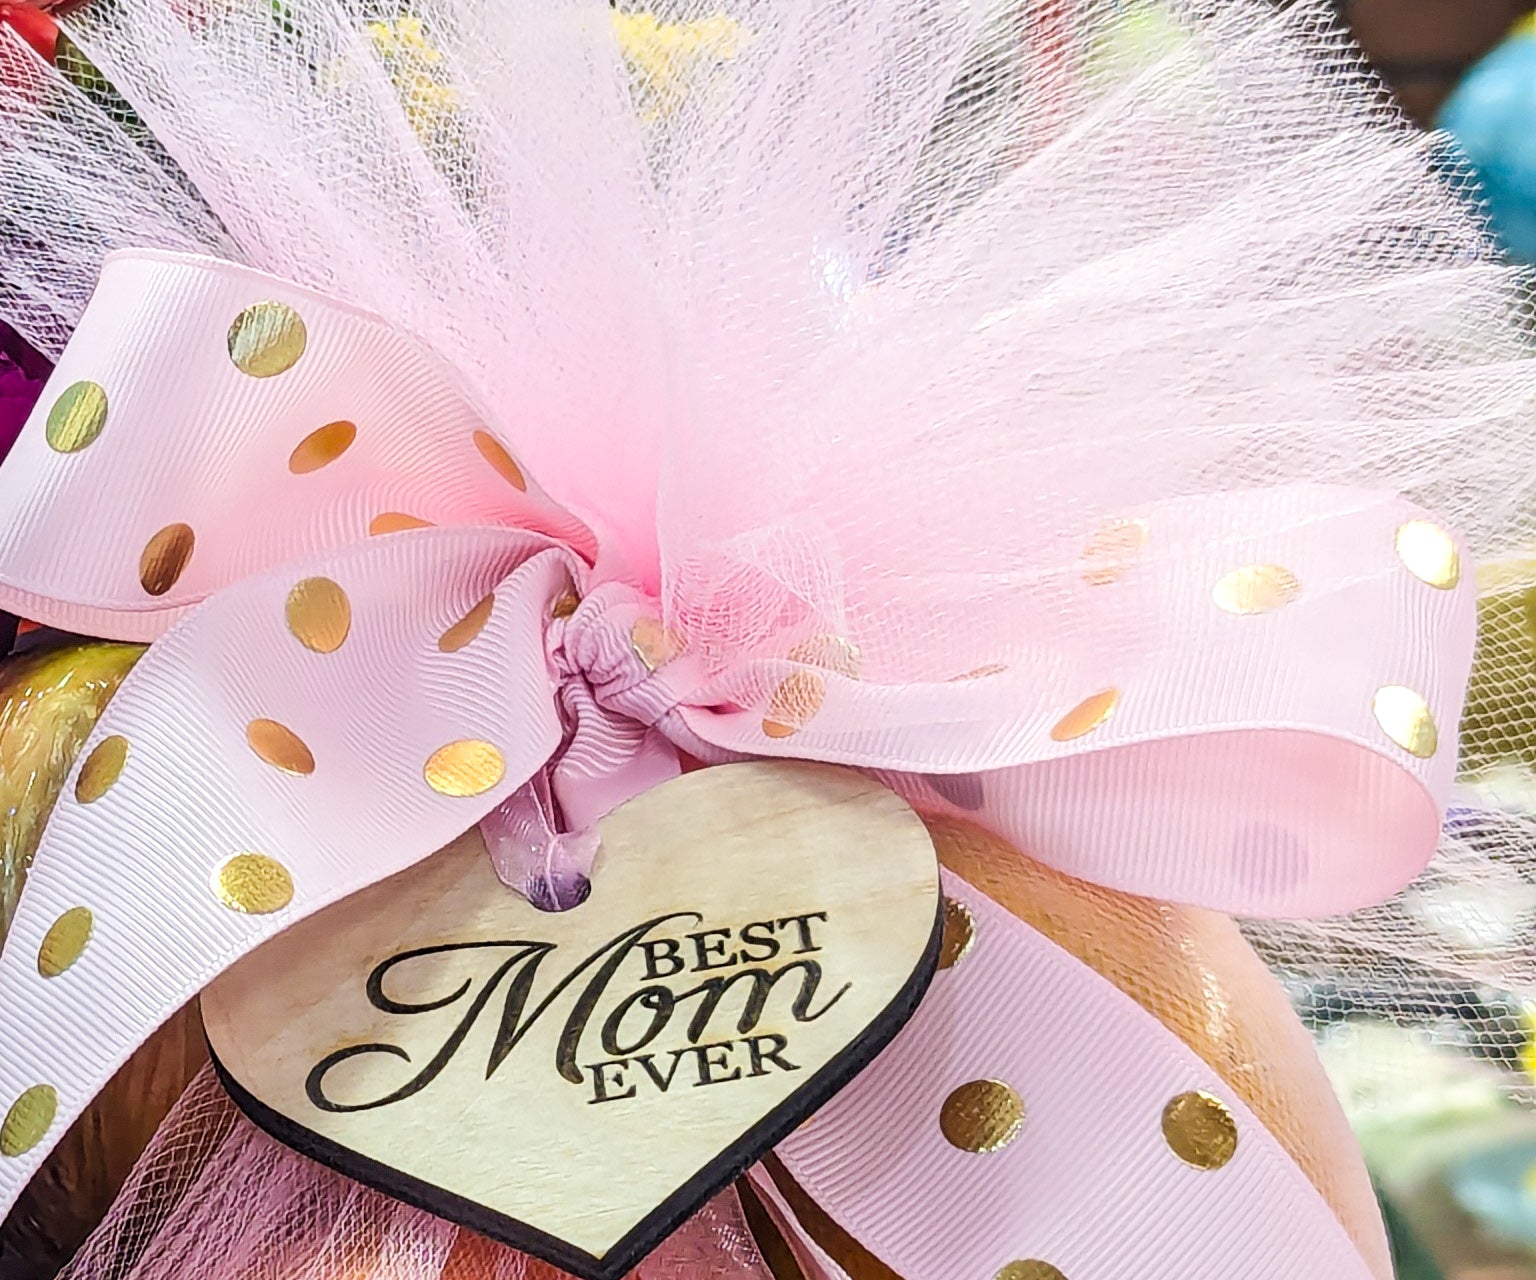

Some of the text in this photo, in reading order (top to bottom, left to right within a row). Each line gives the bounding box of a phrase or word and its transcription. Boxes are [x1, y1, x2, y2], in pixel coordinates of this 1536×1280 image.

[634, 911, 826, 981] BEST
[305, 912, 852, 1113] Mom
[584, 1034, 801, 1104] EVER
